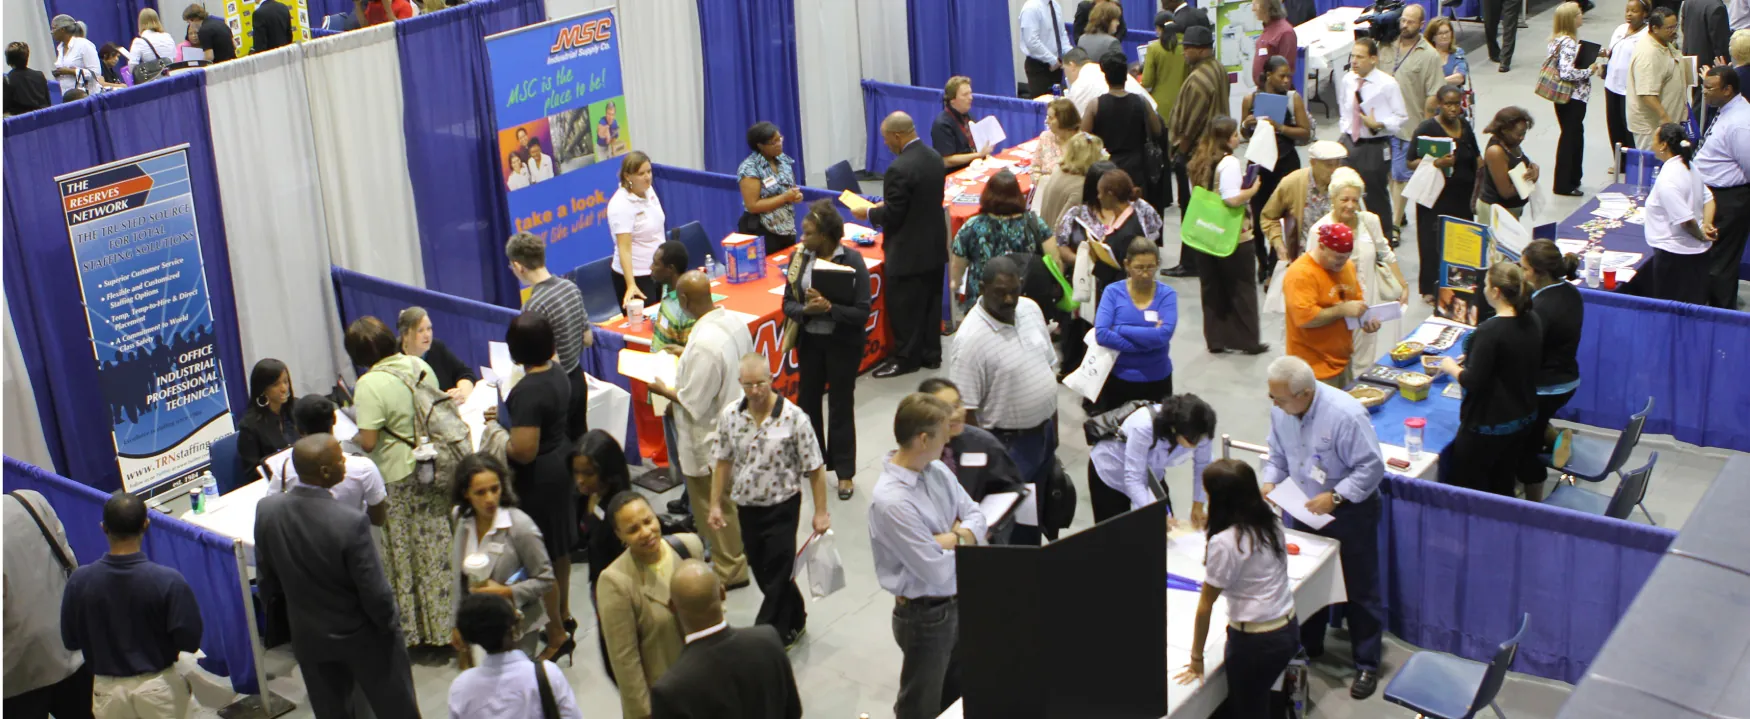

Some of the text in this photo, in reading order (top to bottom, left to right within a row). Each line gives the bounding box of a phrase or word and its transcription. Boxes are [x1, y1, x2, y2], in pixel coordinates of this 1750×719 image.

[550, 17, 611, 55] MSC
[547, 49, 578, 66] Industrial
[578, 44, 600, 58] Supply
[506, 65, 575, 108] MSC is the
[543, 67, 607, 117] place to be!
[66, 179, 90, 195] THE
[69, 186, 121, 210] RESERVES
[72, 198, 130, 224] NETWORK
[77, 203, 191, 245] THE TRUSTED SOURCE
[515, 210, 554, 234] take
[557, 204, 569, 219] a
[82, 231, 195, 273] STAFFING SOLUTIONS
[108, 224, 167, 251] FOR TOTAL
[103, 256, 185, 289] Superior Customer Service
[106, 270, 181, 302] Flexible and Customized
[110, 287, 160, 310] Staffing Options
[111, 288, 199, 324] Temp, Temp-to-Hire & Direct
[114, 314, 147, 332] Placement
[115, 313, 190, 345] A Commitment to World
[119, 335, 155, 353] Class Safety
[179, 343, 214, 364] OFFICE
[156, 357, 216, 387] INDUSTRIAL
[146, 370, 219, 406] PROFESSIONAL
[165, 383, 221, 412] TECHNICAL
[125, 432, 233, 482] www.TRNstaffingcom
[172, 479, 182, 489] est.
